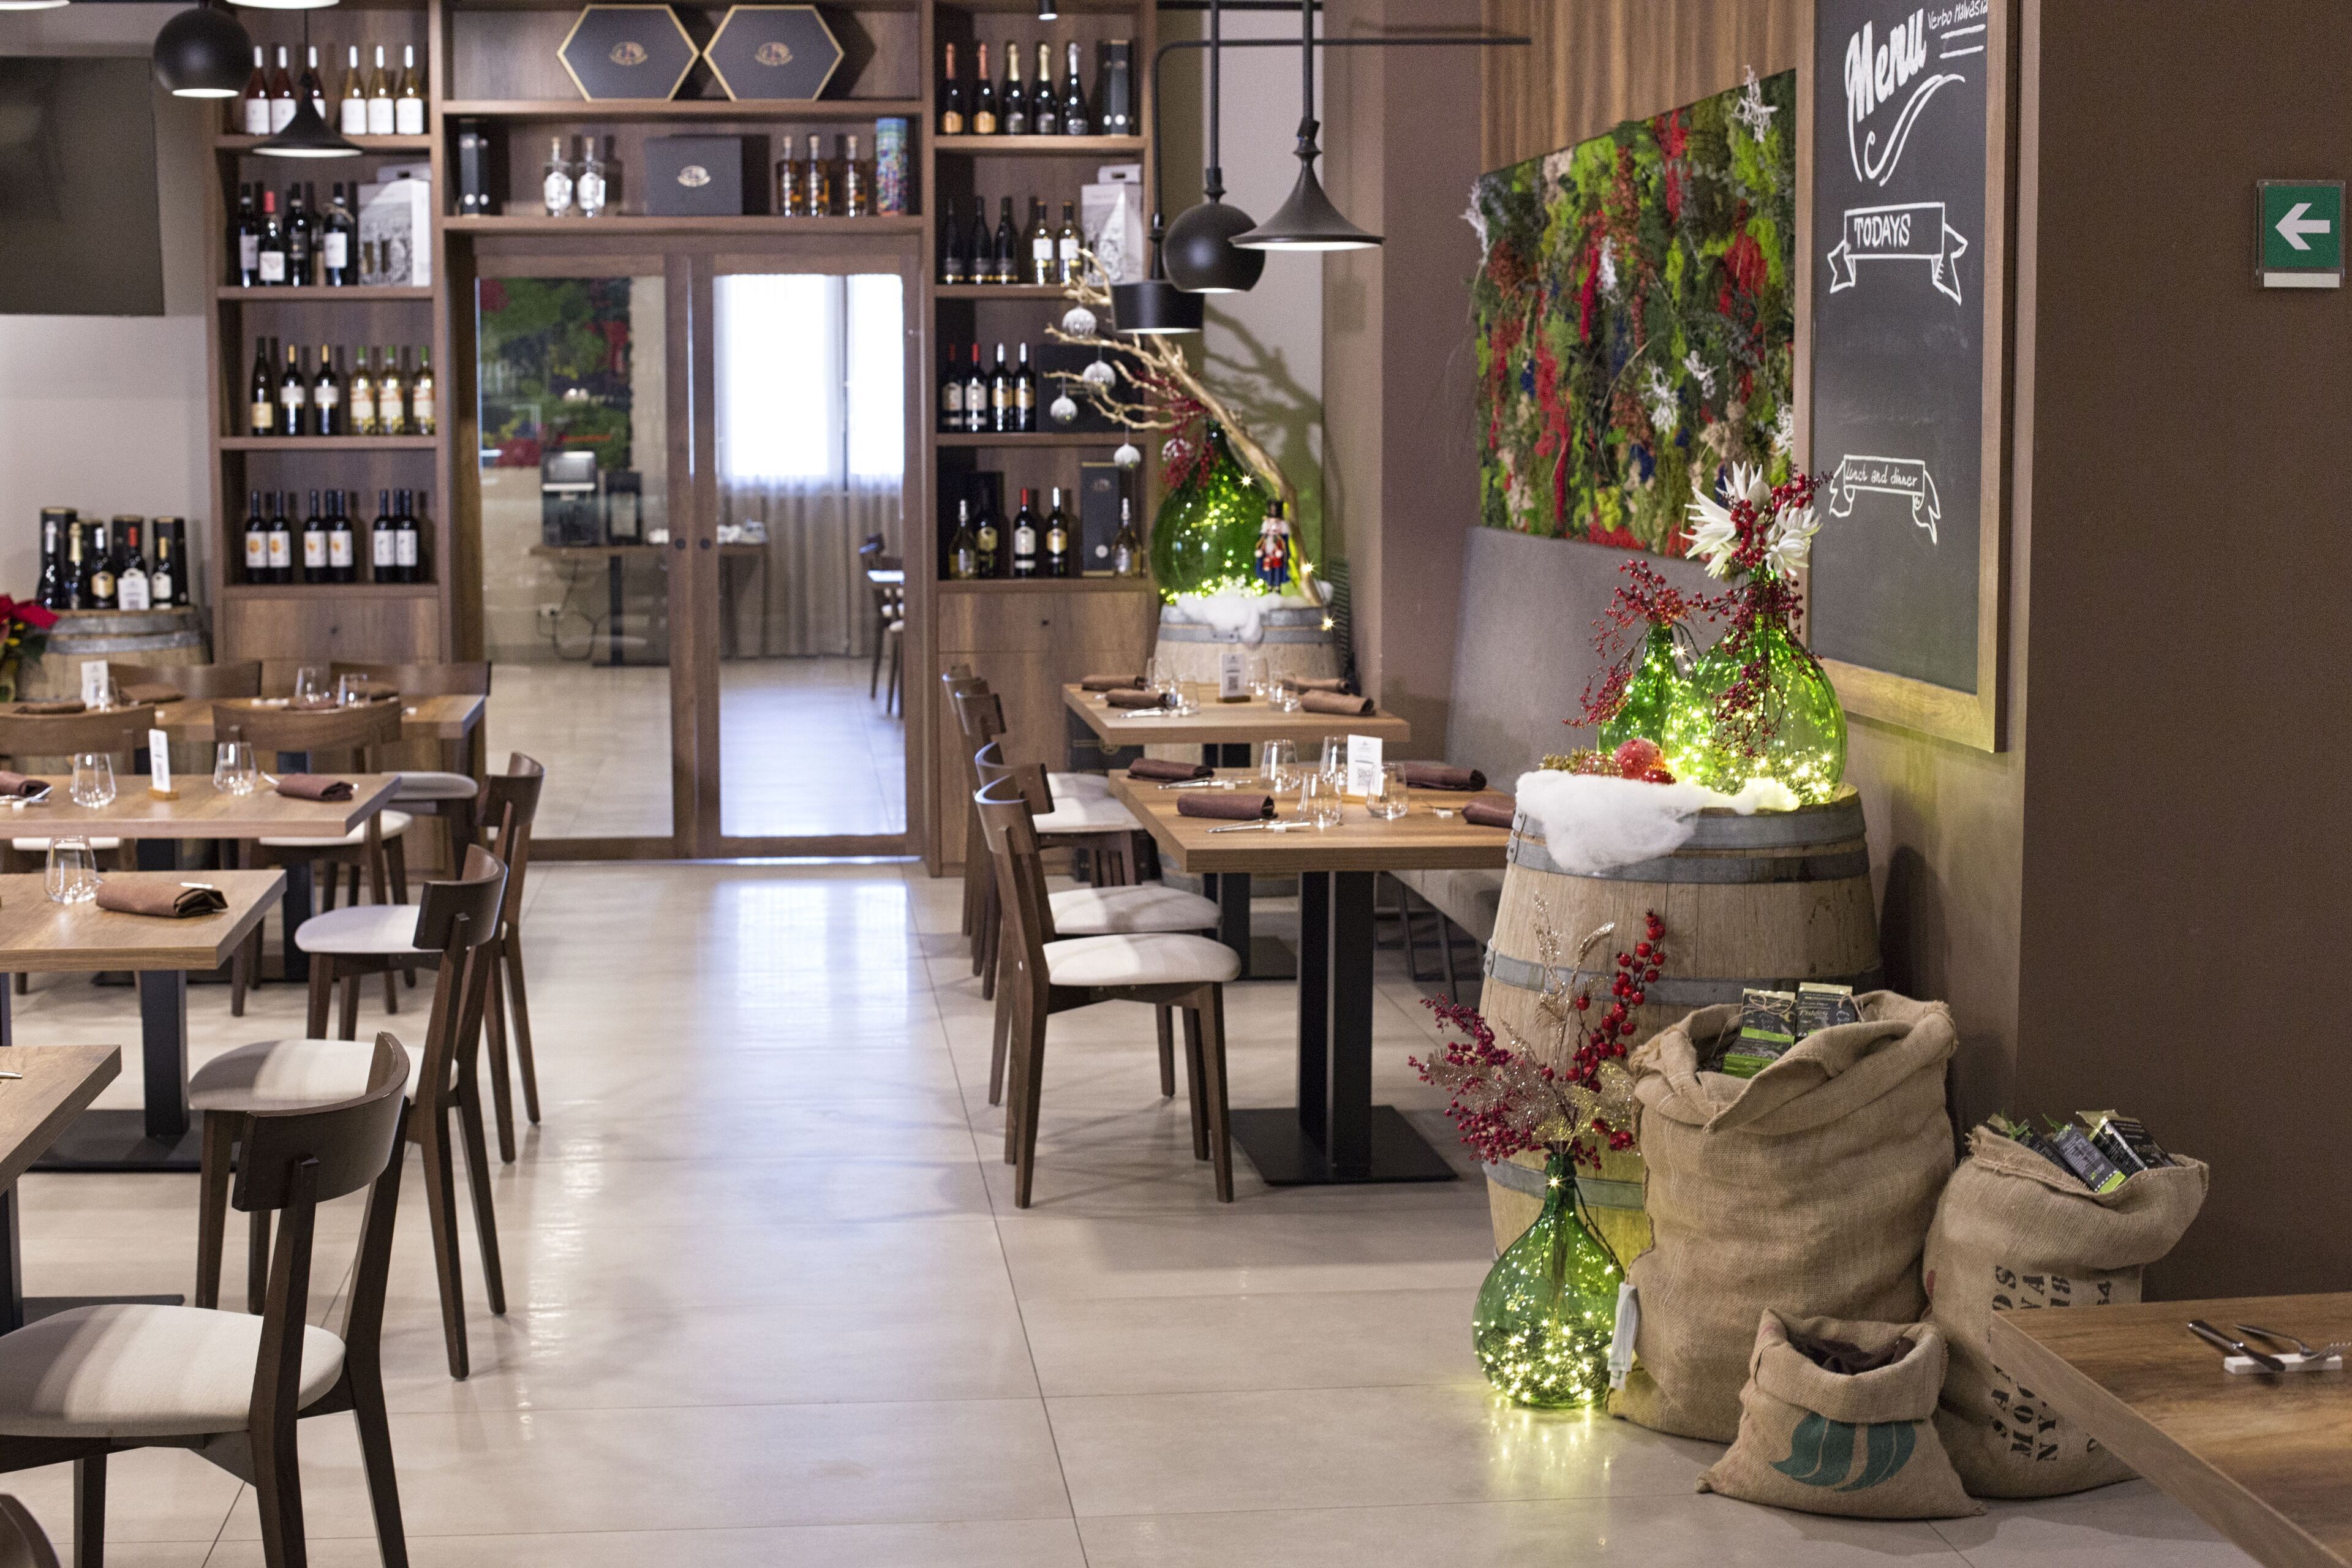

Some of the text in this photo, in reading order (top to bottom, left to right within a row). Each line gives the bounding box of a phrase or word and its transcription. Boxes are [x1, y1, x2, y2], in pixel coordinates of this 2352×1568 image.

[1928, 9, 1952, 29] Verbo
[1845, 8, 1927, 182] Menu
[1871, 464, 1888, 483] and
[1890, 467, 1917, 487] dinner
